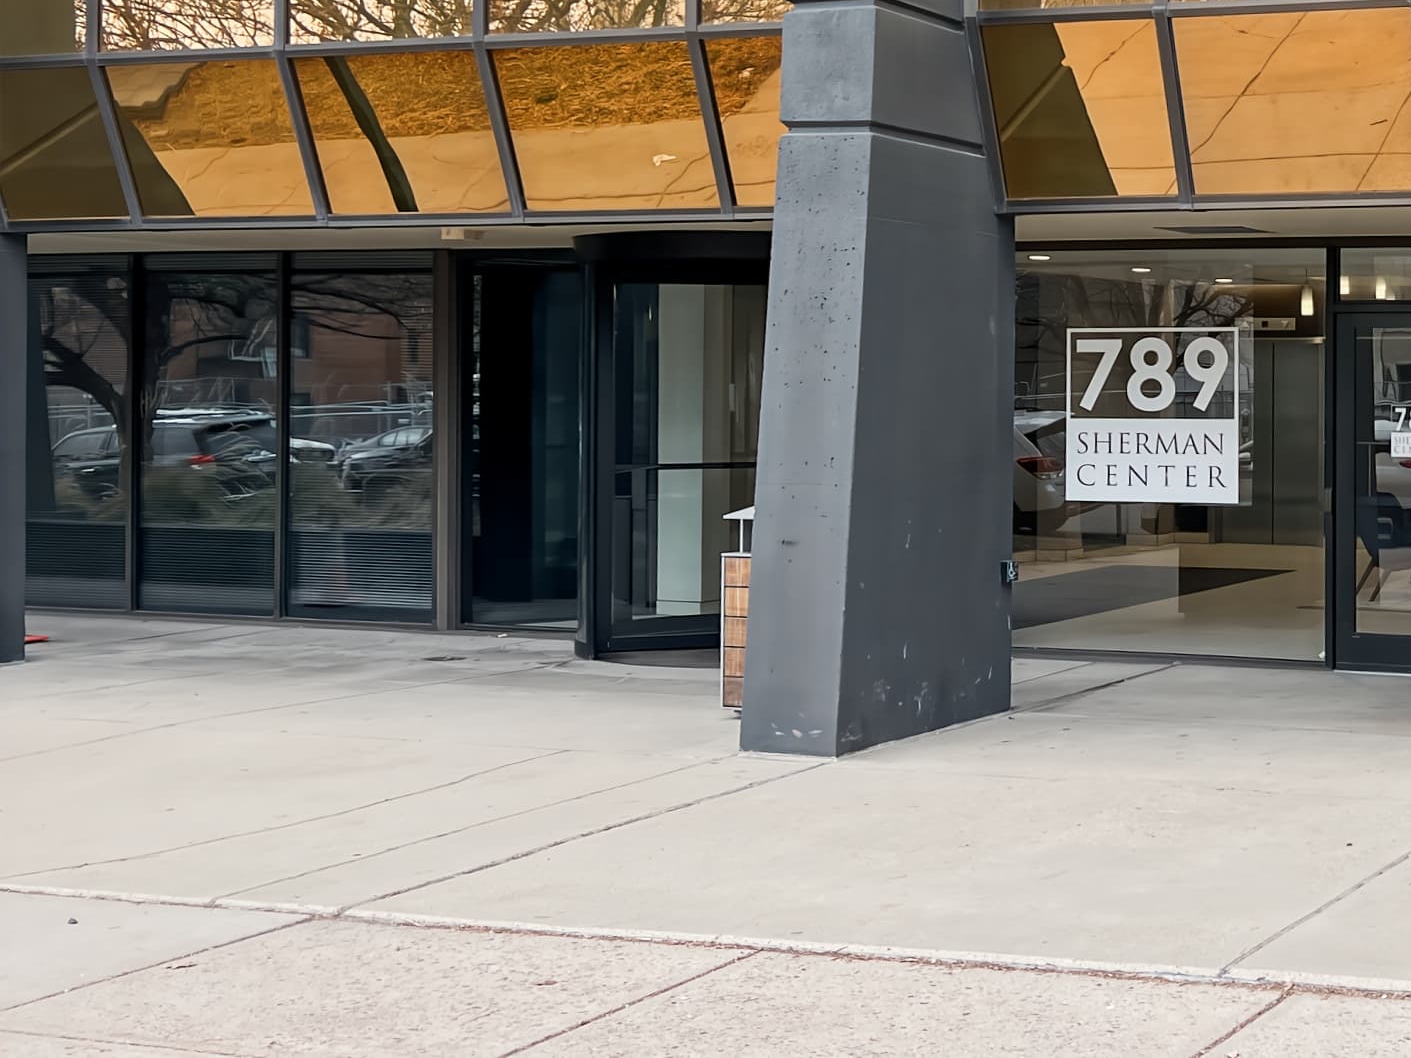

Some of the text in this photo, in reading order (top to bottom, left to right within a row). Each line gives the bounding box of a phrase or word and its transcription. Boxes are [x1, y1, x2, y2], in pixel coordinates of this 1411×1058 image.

[1076, 337, 1229, 412] 789
[1076, 431, 1224, 455] SHERMAN
[1076, 463, 1227, 488] CENTER
